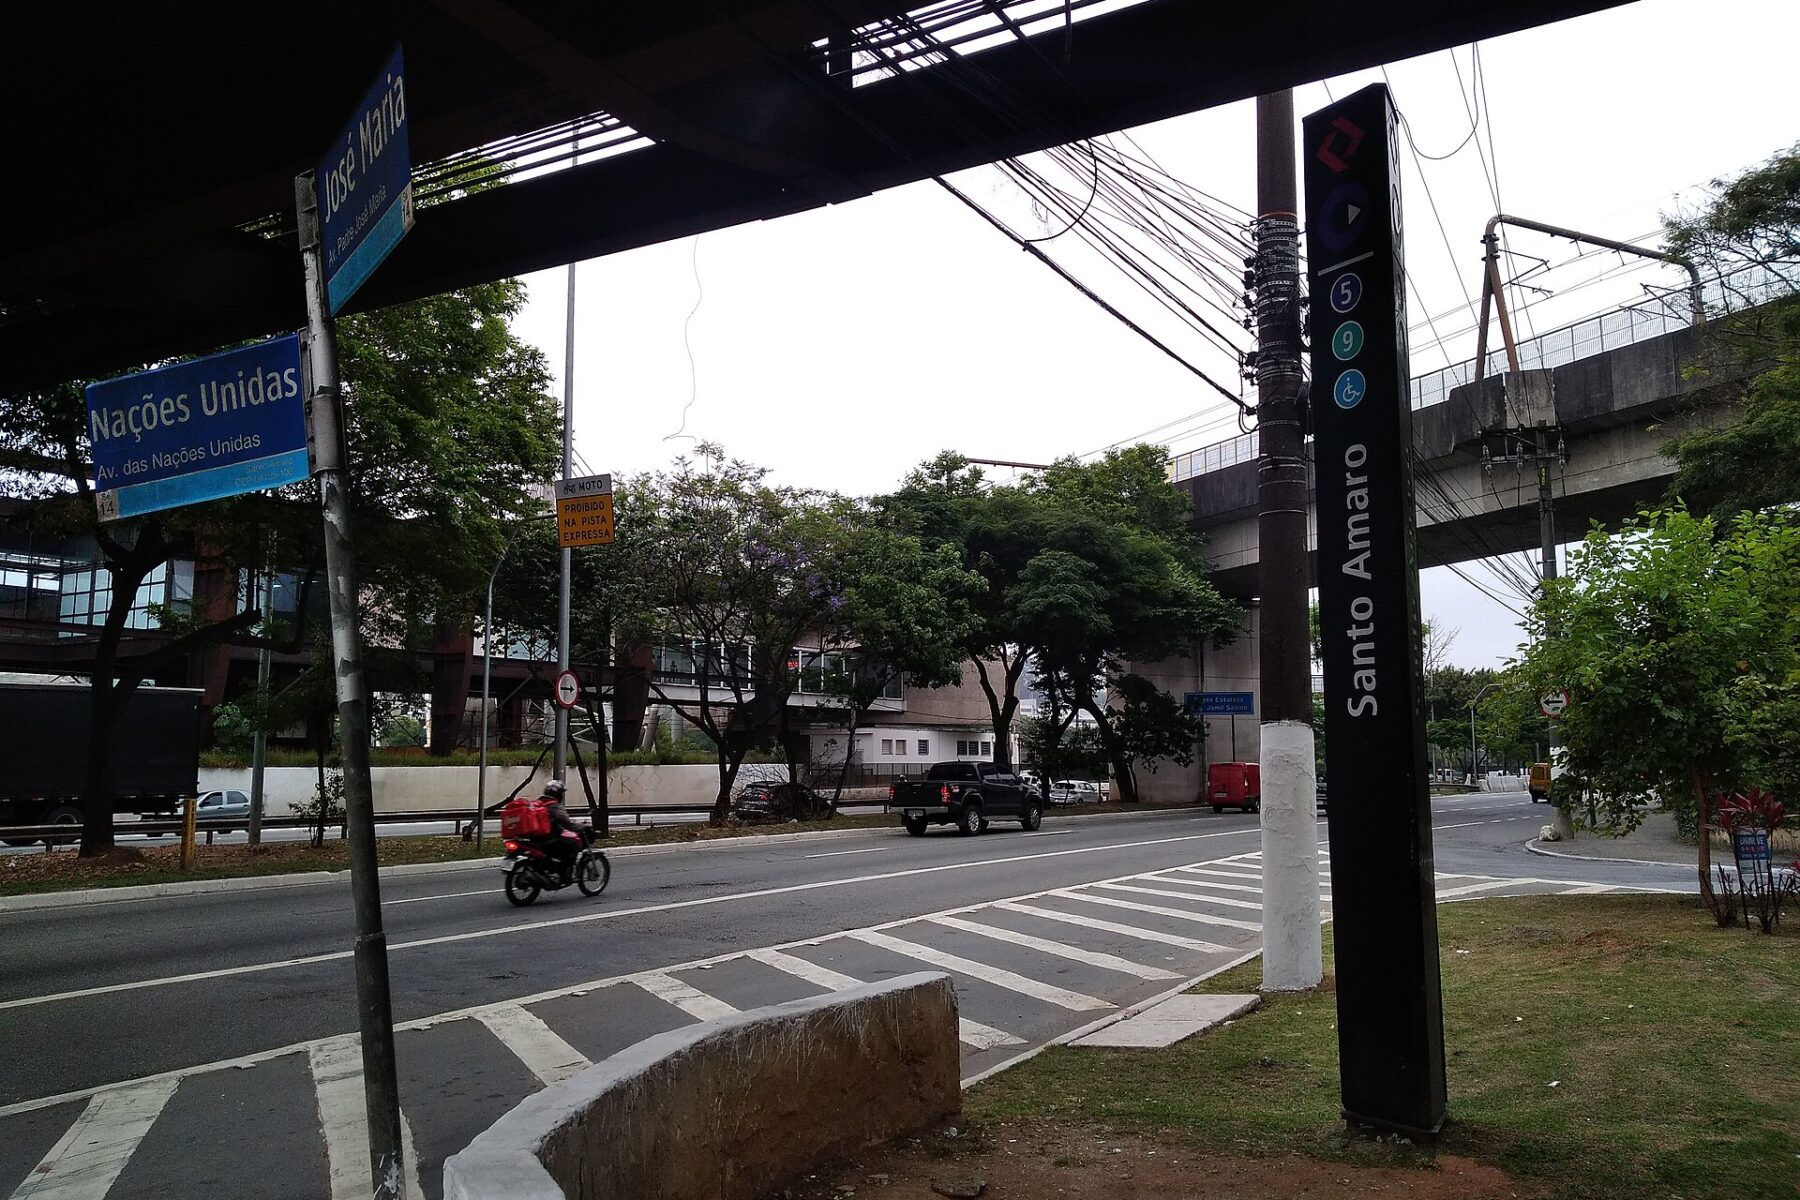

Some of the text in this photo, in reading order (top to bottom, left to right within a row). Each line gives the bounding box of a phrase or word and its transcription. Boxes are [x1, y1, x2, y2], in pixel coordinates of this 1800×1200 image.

[325, 73, 405, 224] José Maria
[328, 184, 387, 268] Av. Padre José Maria
[1339, 282, 1353, 306] 5
[1341, 329, 1355, 353] 9
[91, 366, 298, 443] Nações Unidas
[97, 431, 261, 481] Av. das Nações Unidas
[578, 480, 603, 492] MOTO
[99, 500, 114, 516] 14
[564, 501, 605, 513] PROIBIDO
[564, 515, 607, 528] NA PISTA
[563, 530, 610, 542] EXPRESSA
[1342, 443, 1378, 719] Santo Amaro
